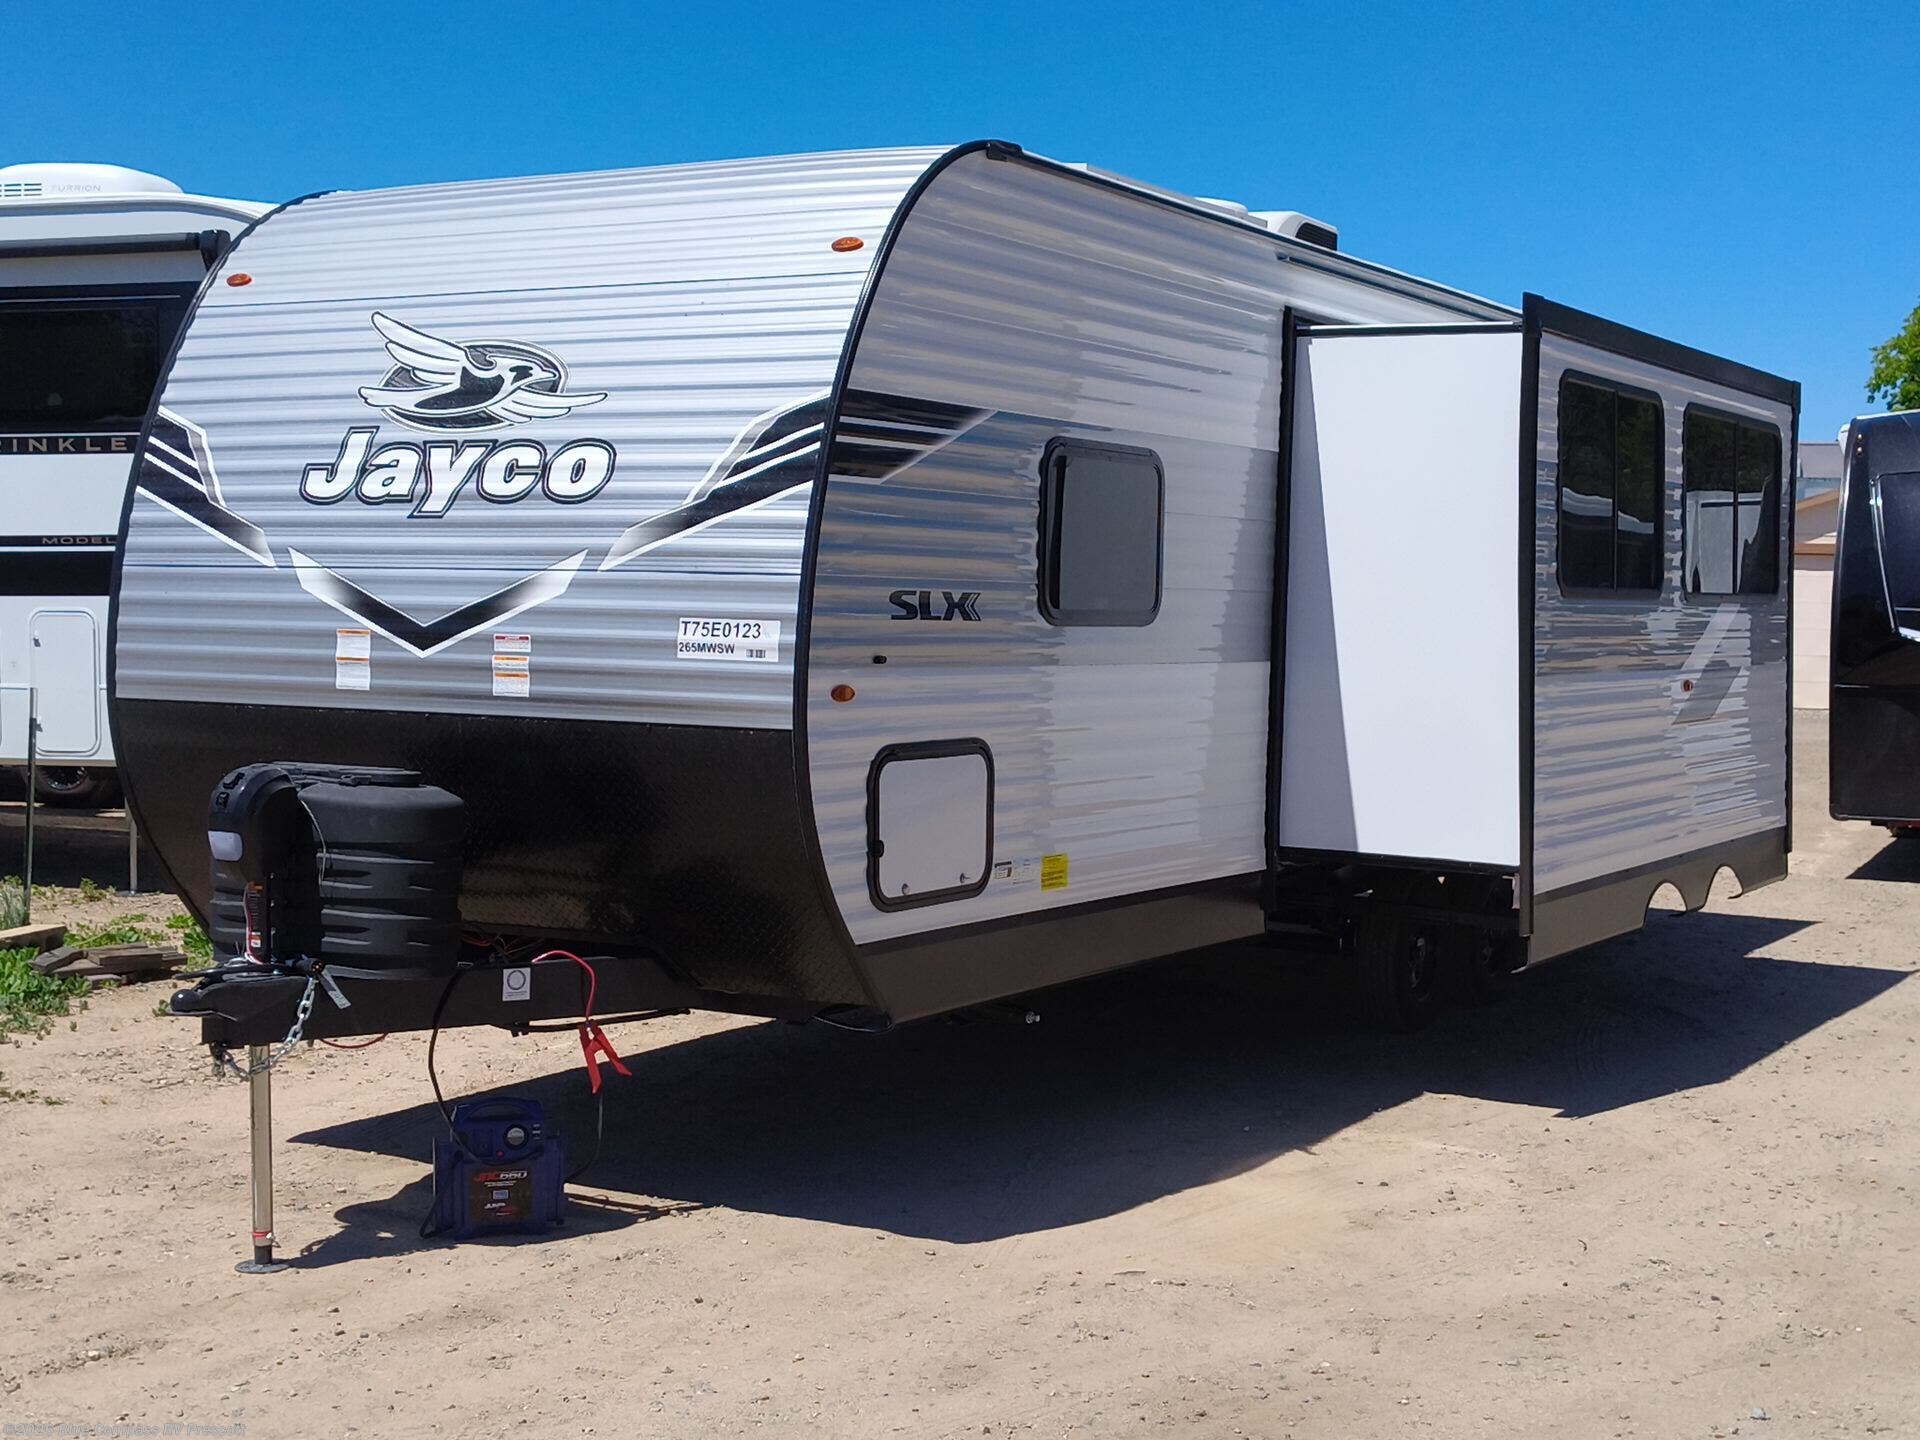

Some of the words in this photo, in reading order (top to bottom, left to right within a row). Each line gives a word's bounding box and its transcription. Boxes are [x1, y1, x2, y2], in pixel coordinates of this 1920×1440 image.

[0, 437, 128, 453] INKLE
[299, 425, 617, 518] Jayco
[42, 536, 118, 545] MODEL
[888, 590, 982, 621] SLX
[681, 621, 761, 639] T75E0123
[678, 642, 735, 654] 265MWSW
